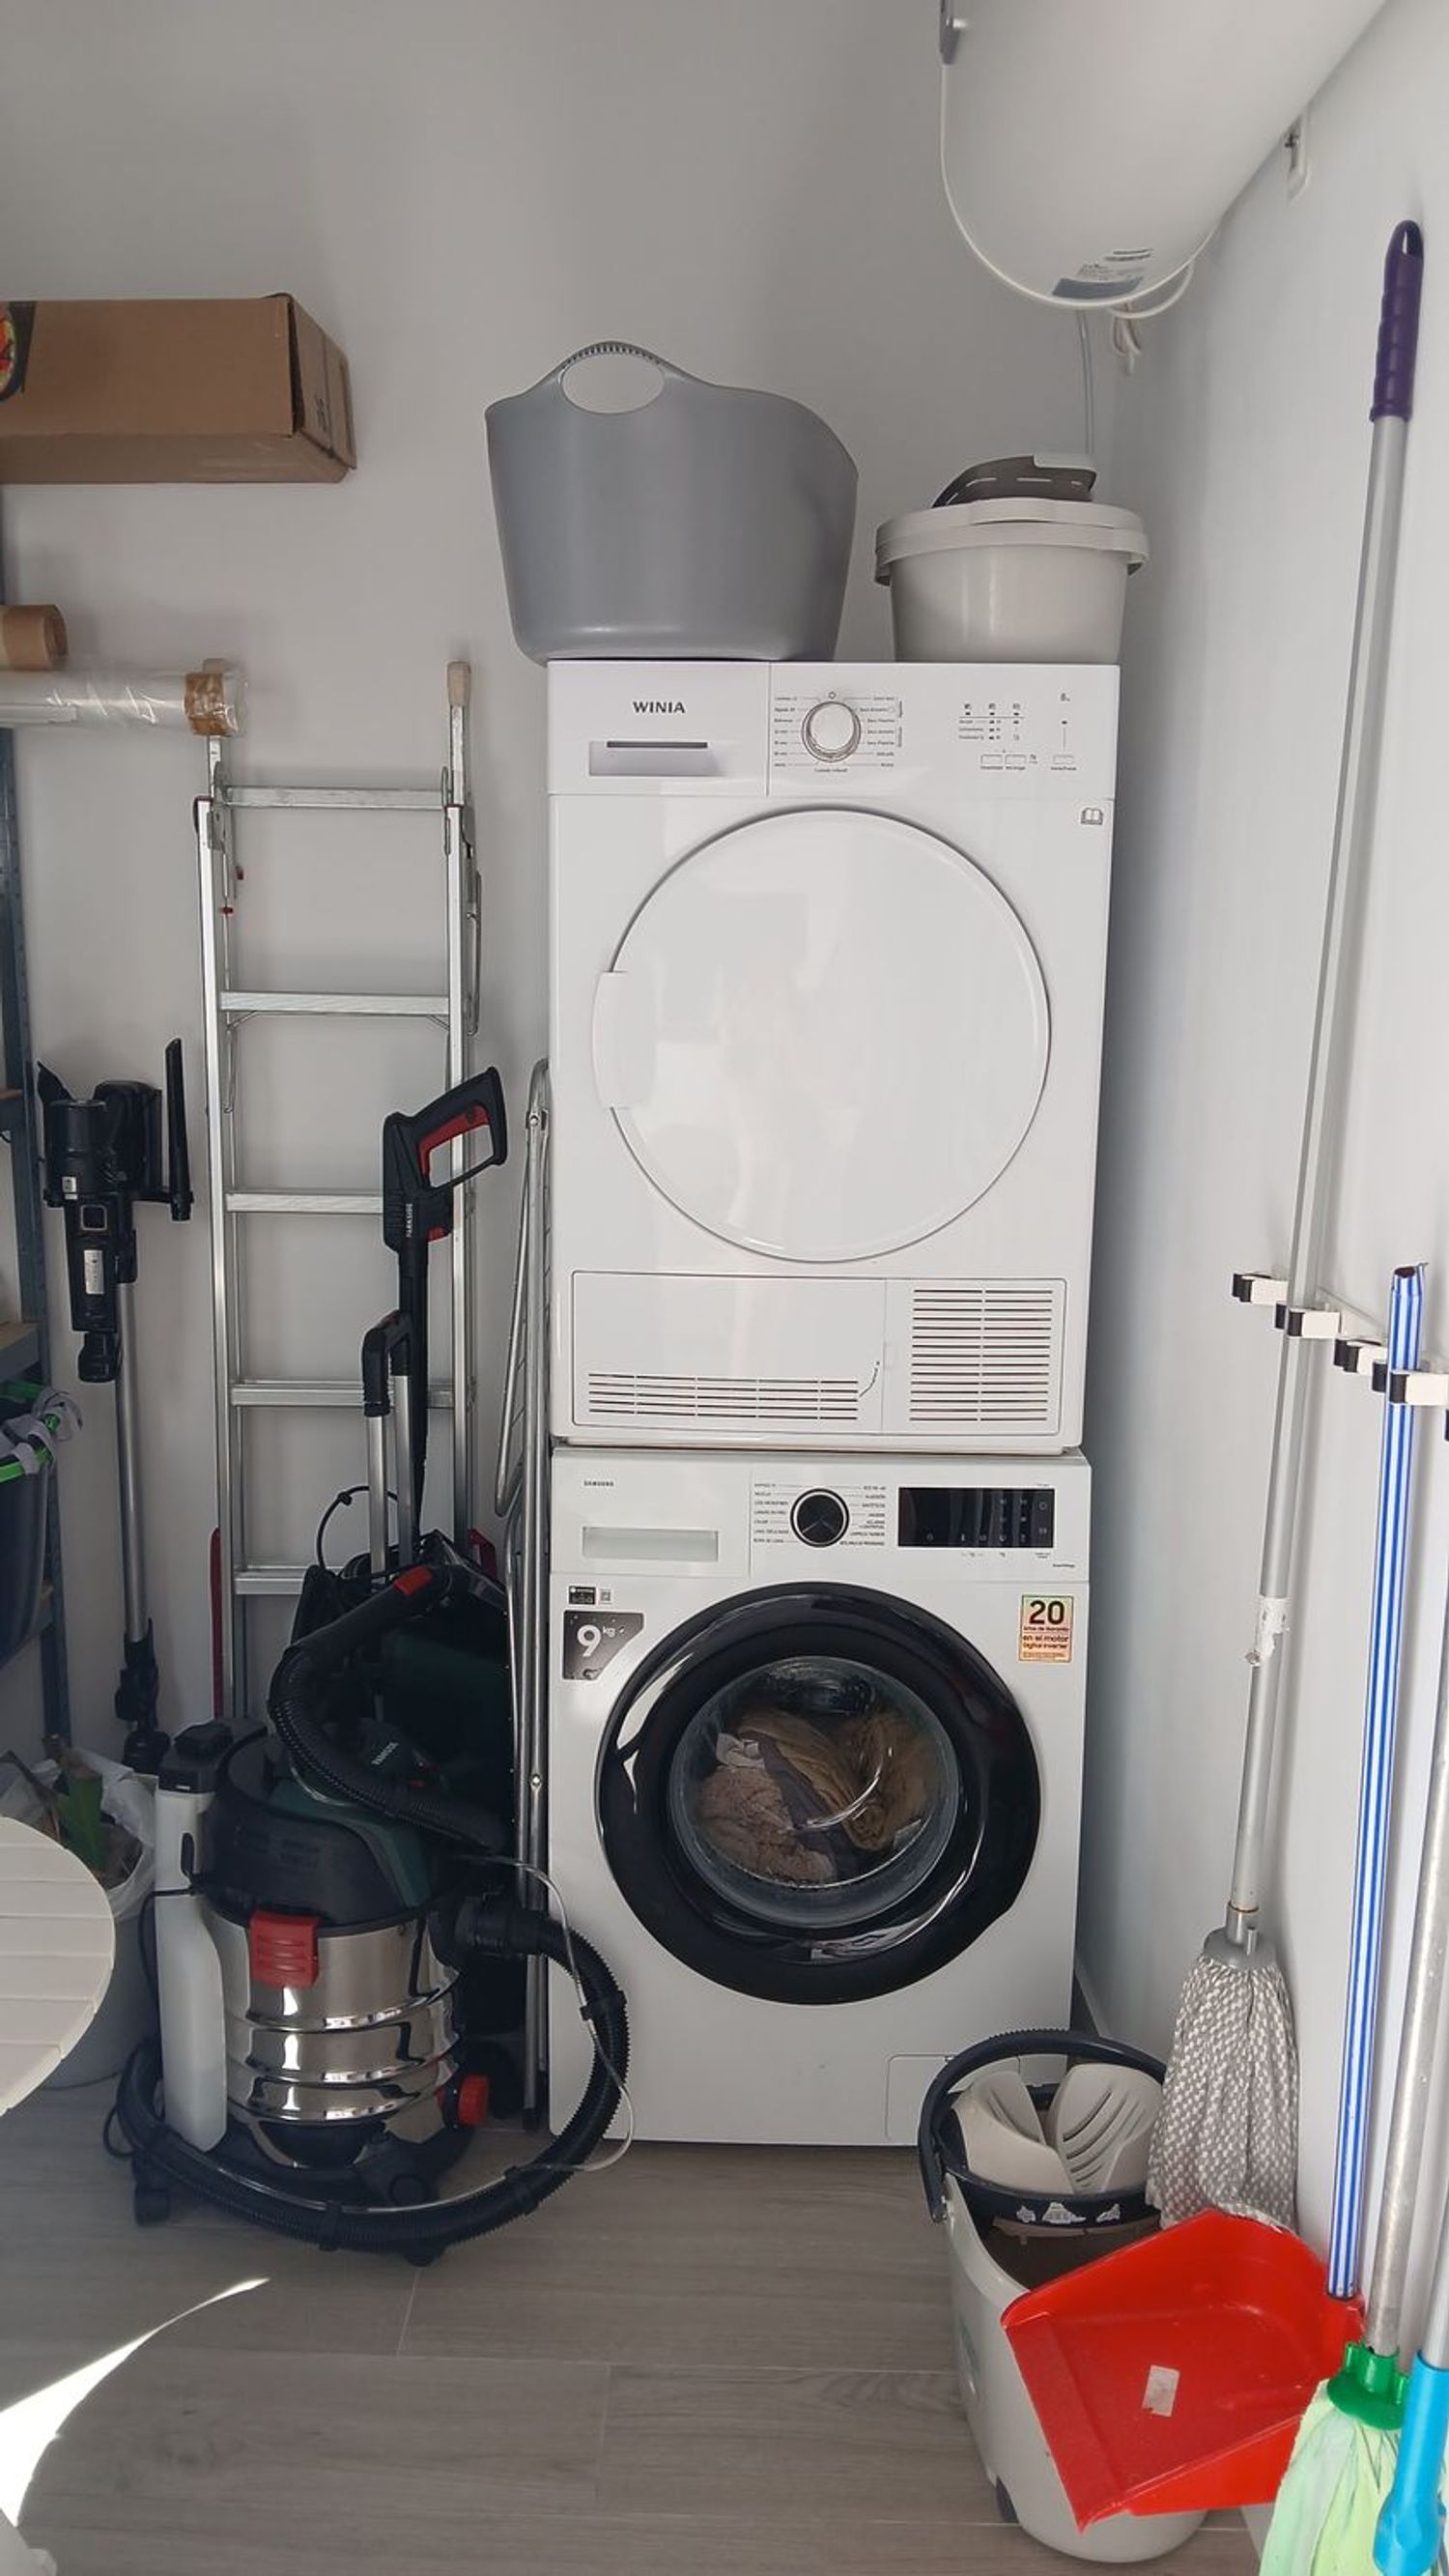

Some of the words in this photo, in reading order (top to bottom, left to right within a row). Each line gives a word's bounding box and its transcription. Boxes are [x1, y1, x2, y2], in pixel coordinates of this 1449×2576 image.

[633, 701, 686, 714] WINIA
[1029, 1600, 1065, 1625] 20
[577, 1624, 602, 1657] 9
[602, 1625, 616, 1638] kg
